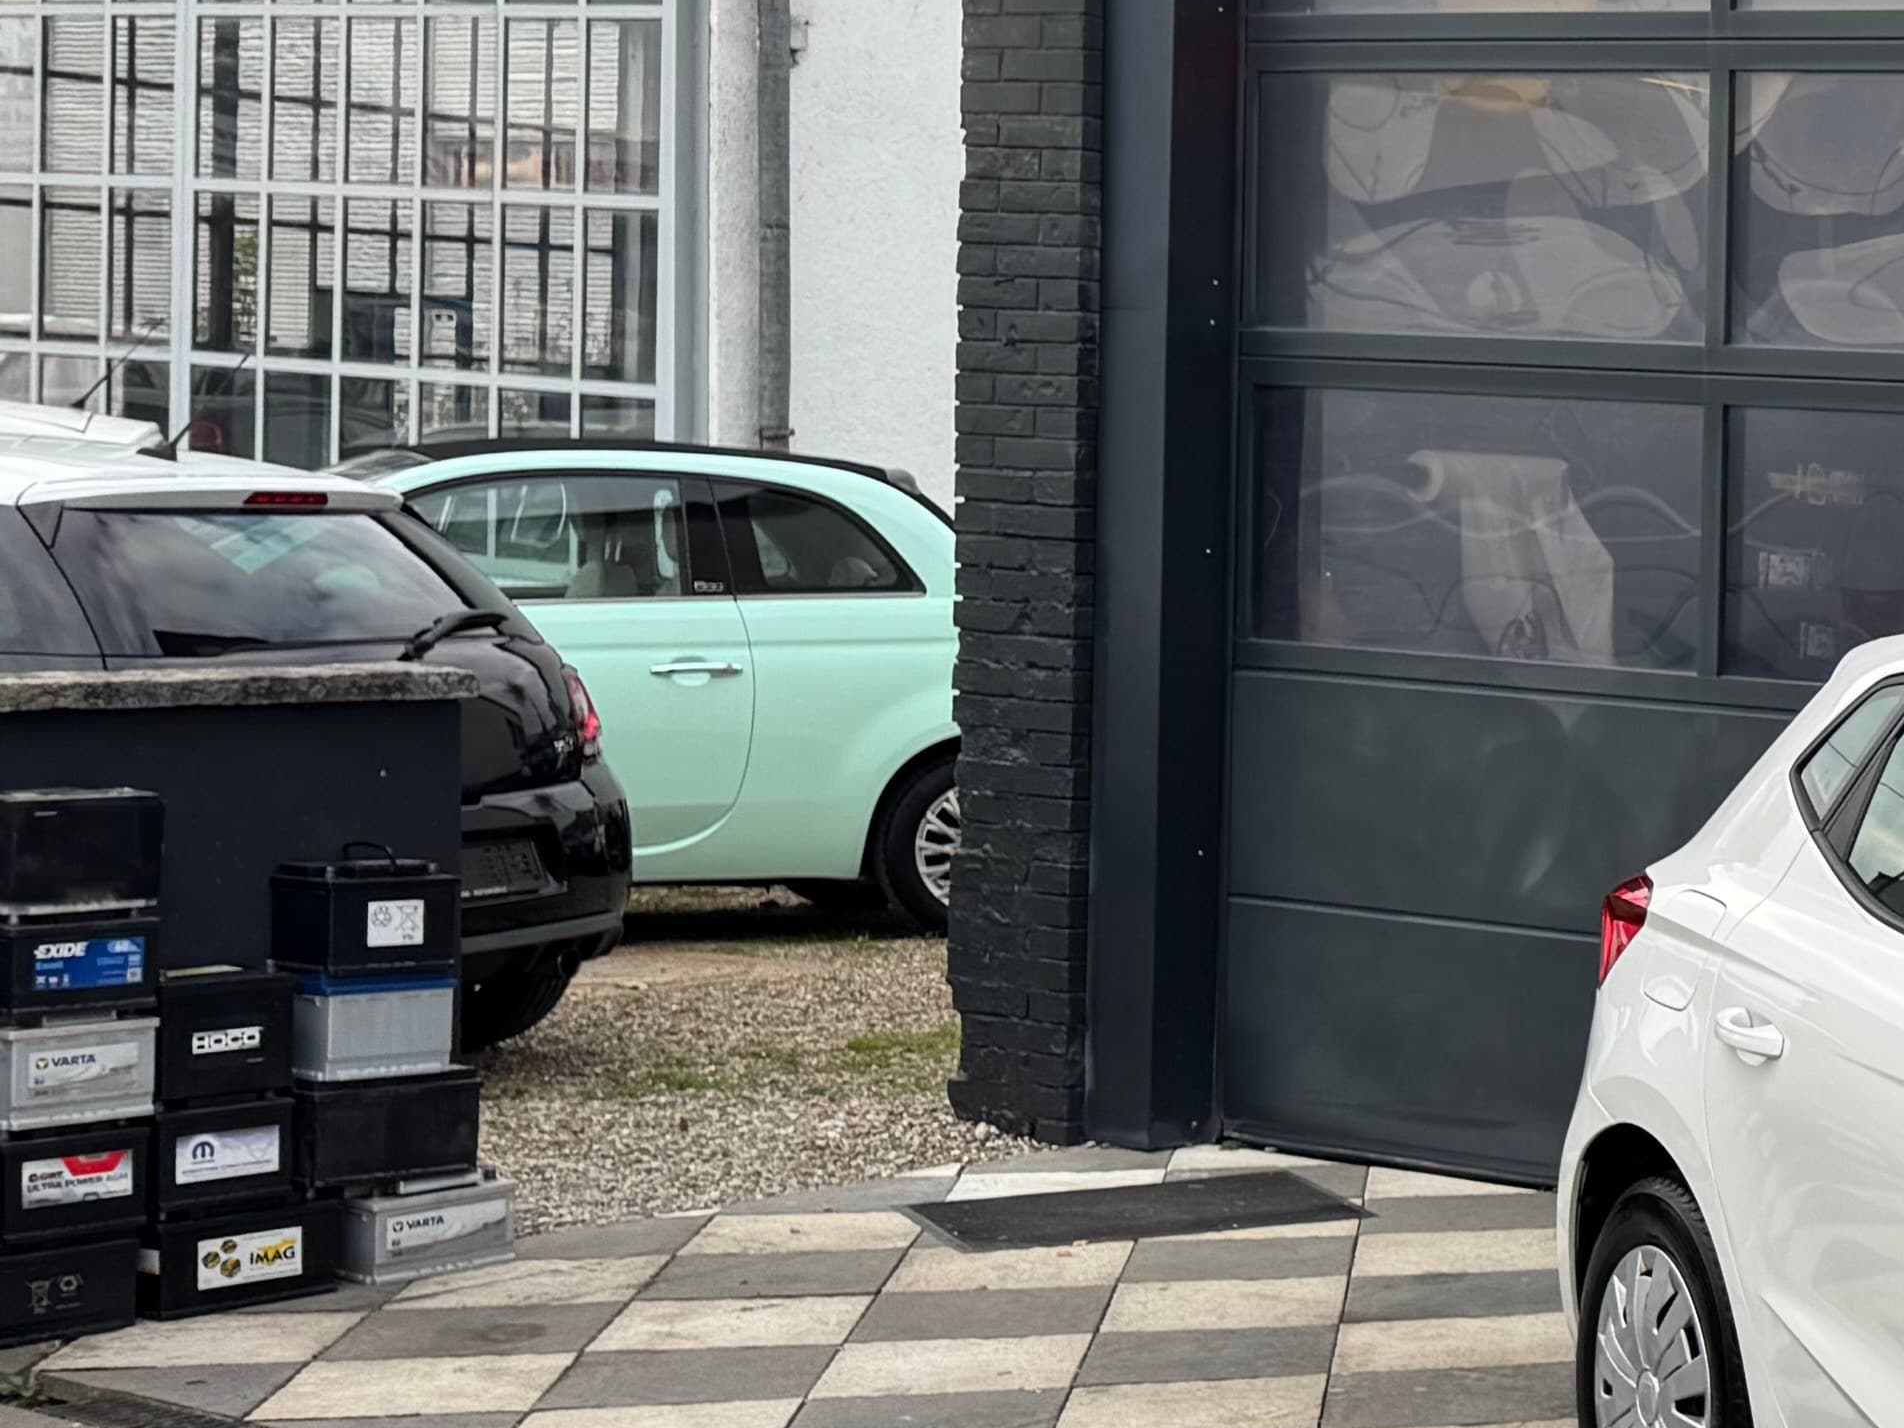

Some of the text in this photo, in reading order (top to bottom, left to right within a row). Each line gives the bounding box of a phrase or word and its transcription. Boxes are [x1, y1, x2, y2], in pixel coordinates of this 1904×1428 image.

[33, 941, 89, 960] EXIDE
[52, 1054, 96, 1067] VARTA
[406, 1215, 444, 1229] VARTA
[249, 1245, 296, 1265] IMAG
